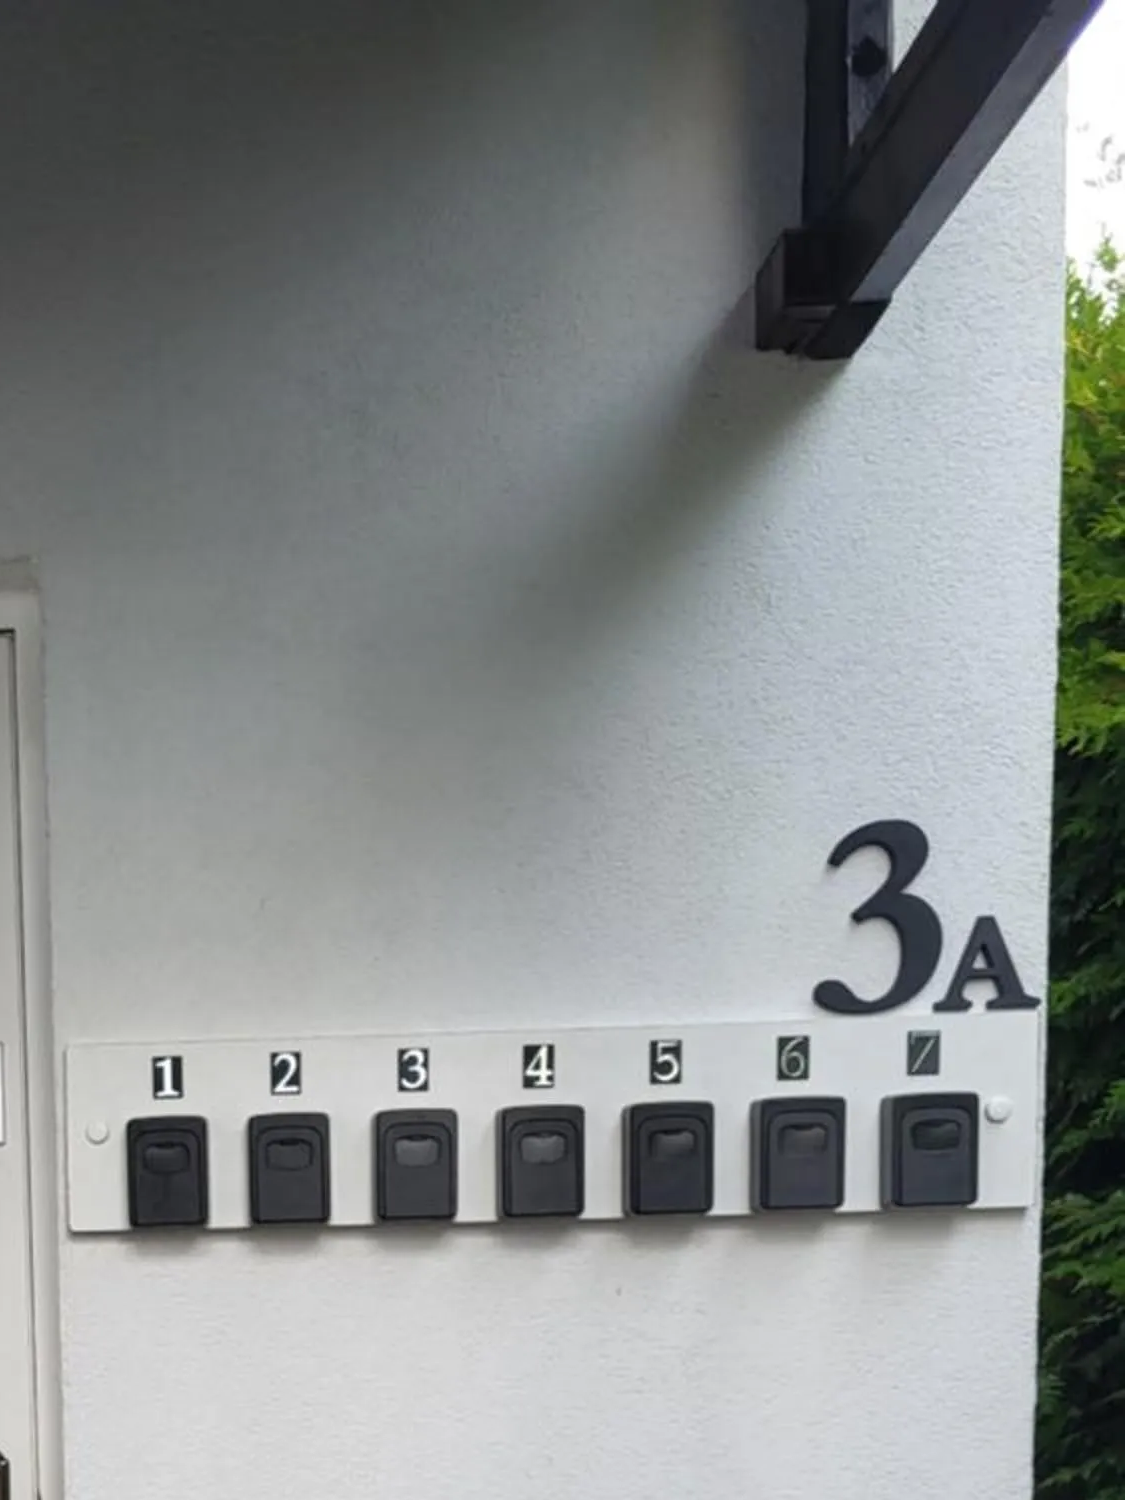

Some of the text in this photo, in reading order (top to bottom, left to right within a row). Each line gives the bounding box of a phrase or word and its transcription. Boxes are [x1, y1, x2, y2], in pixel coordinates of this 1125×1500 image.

[812, 819, 1041, 1015] 3A
[154, 1031, 939, 1098] 1 2 3 4 5 6 7
